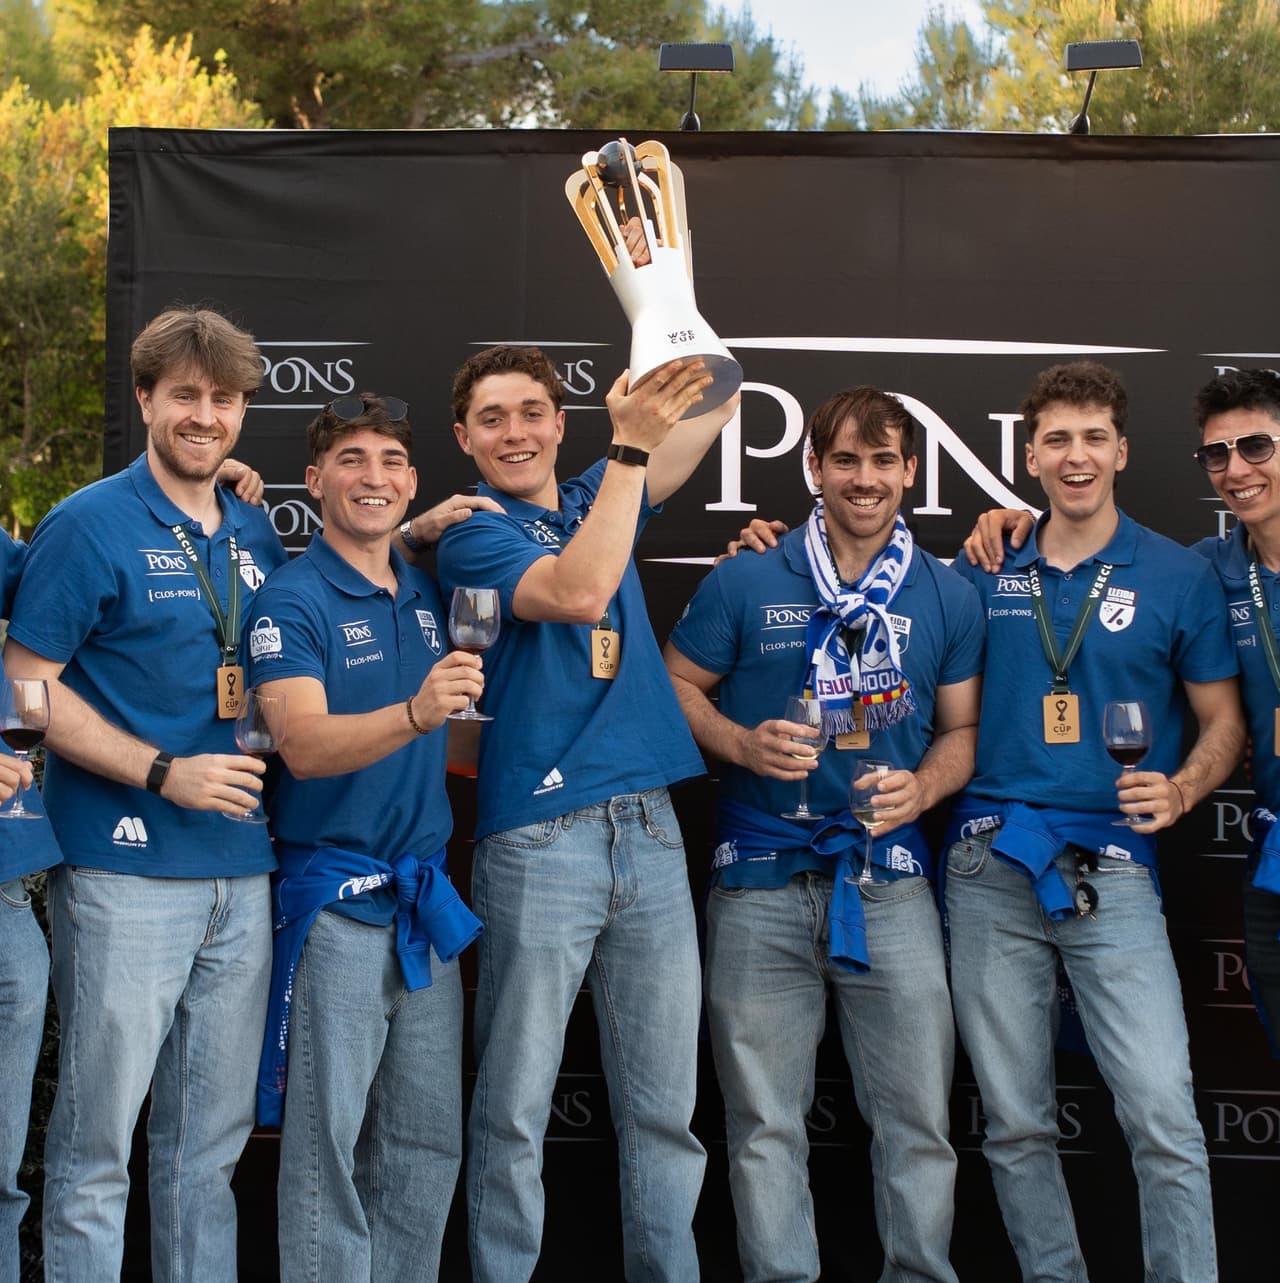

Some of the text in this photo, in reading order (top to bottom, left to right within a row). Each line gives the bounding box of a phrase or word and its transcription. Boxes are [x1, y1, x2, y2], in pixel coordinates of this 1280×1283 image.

[667, 329, 694, 340] WSE
[670, 335, 696, 345] CUP
[145, 553, 188, 570] PONS
[996, 578, 1032, 593] PONS
[765, 609, 810, 625] PONS
[251, 633, 279, 648] PONS
[343, 625, 373, 642] PONS
[765, 642, 786, 651] CLOS
[1053, 725, 1072, 734] CUP
